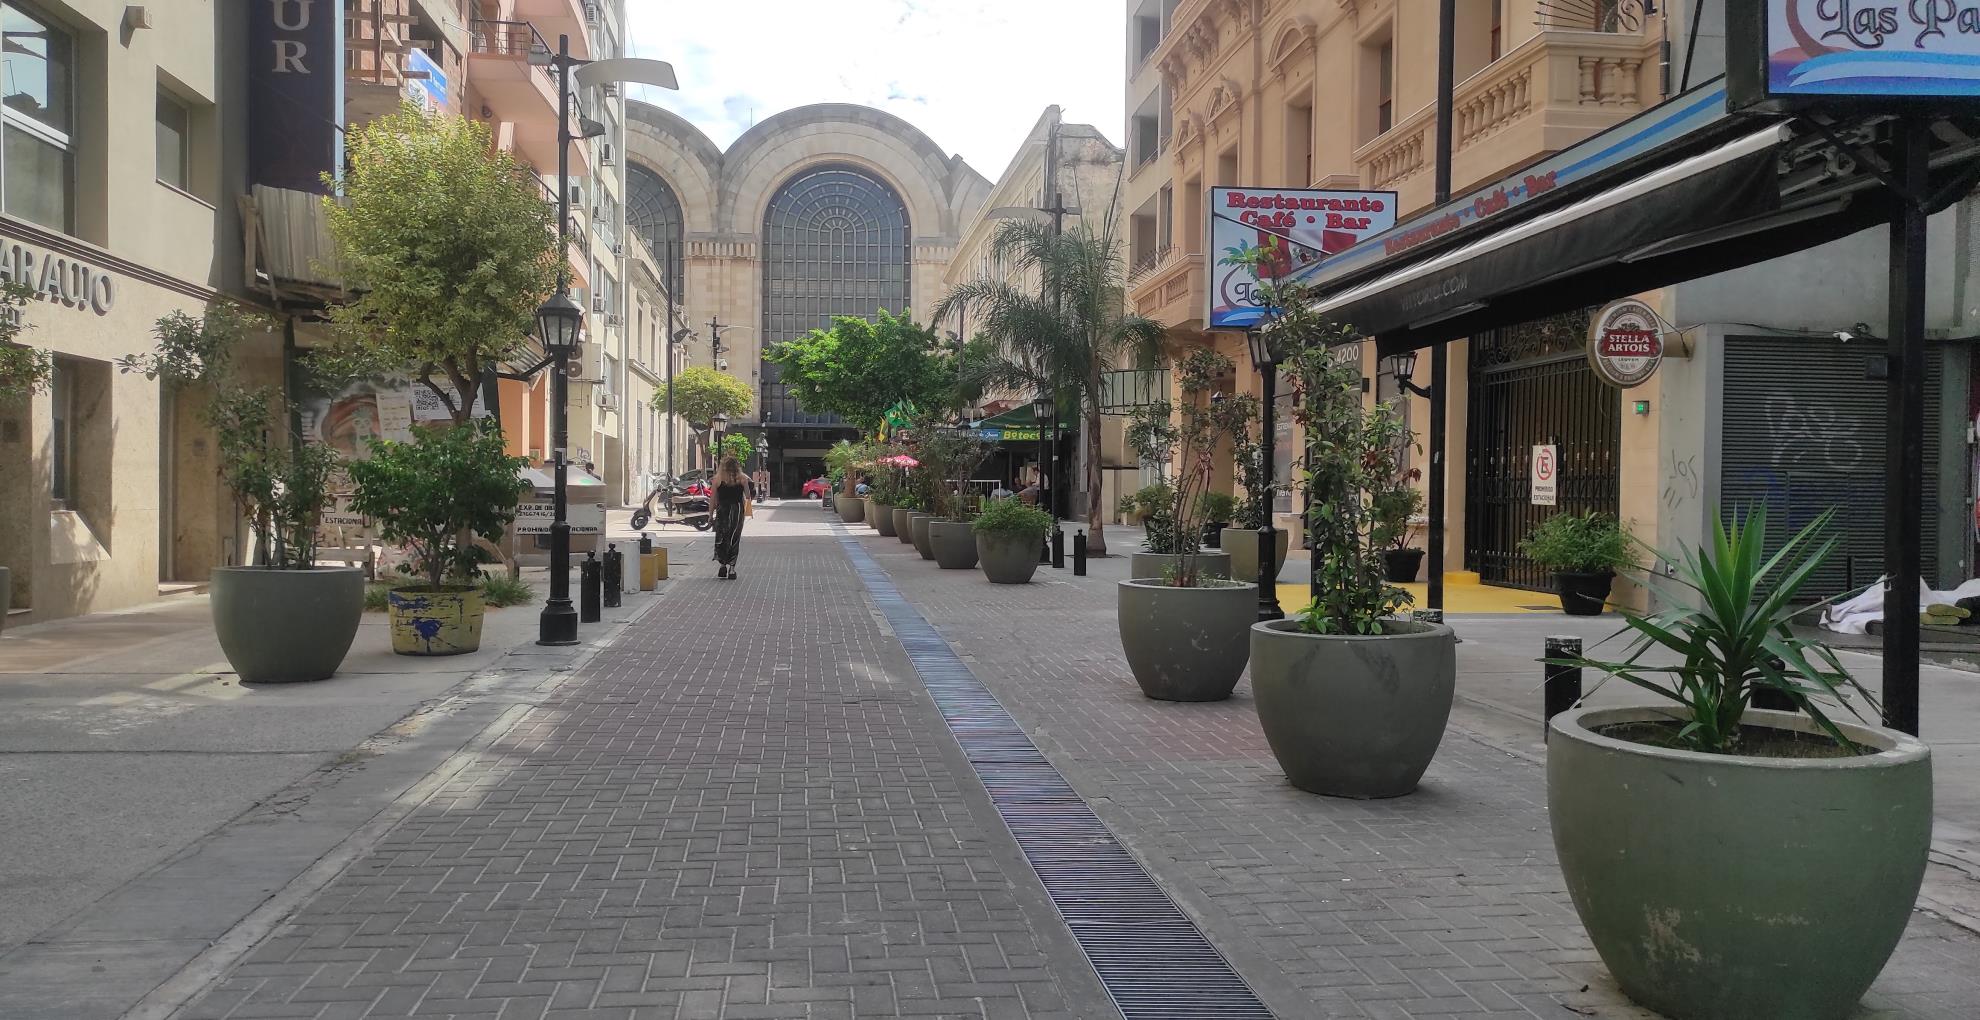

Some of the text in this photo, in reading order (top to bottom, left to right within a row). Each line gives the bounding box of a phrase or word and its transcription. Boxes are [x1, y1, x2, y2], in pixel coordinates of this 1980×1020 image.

[1226, 191, 1385, 213] Restaurante
[1239, 210, 1373, 230] Café Bar
[1384, 170, 1558, 257] Restaurante Café Bar
[1233, 282, 1267, 307] La
[1607, 343, 1651, 353] ARTOIS
[1608, 334, 1651, 343] STELLA
